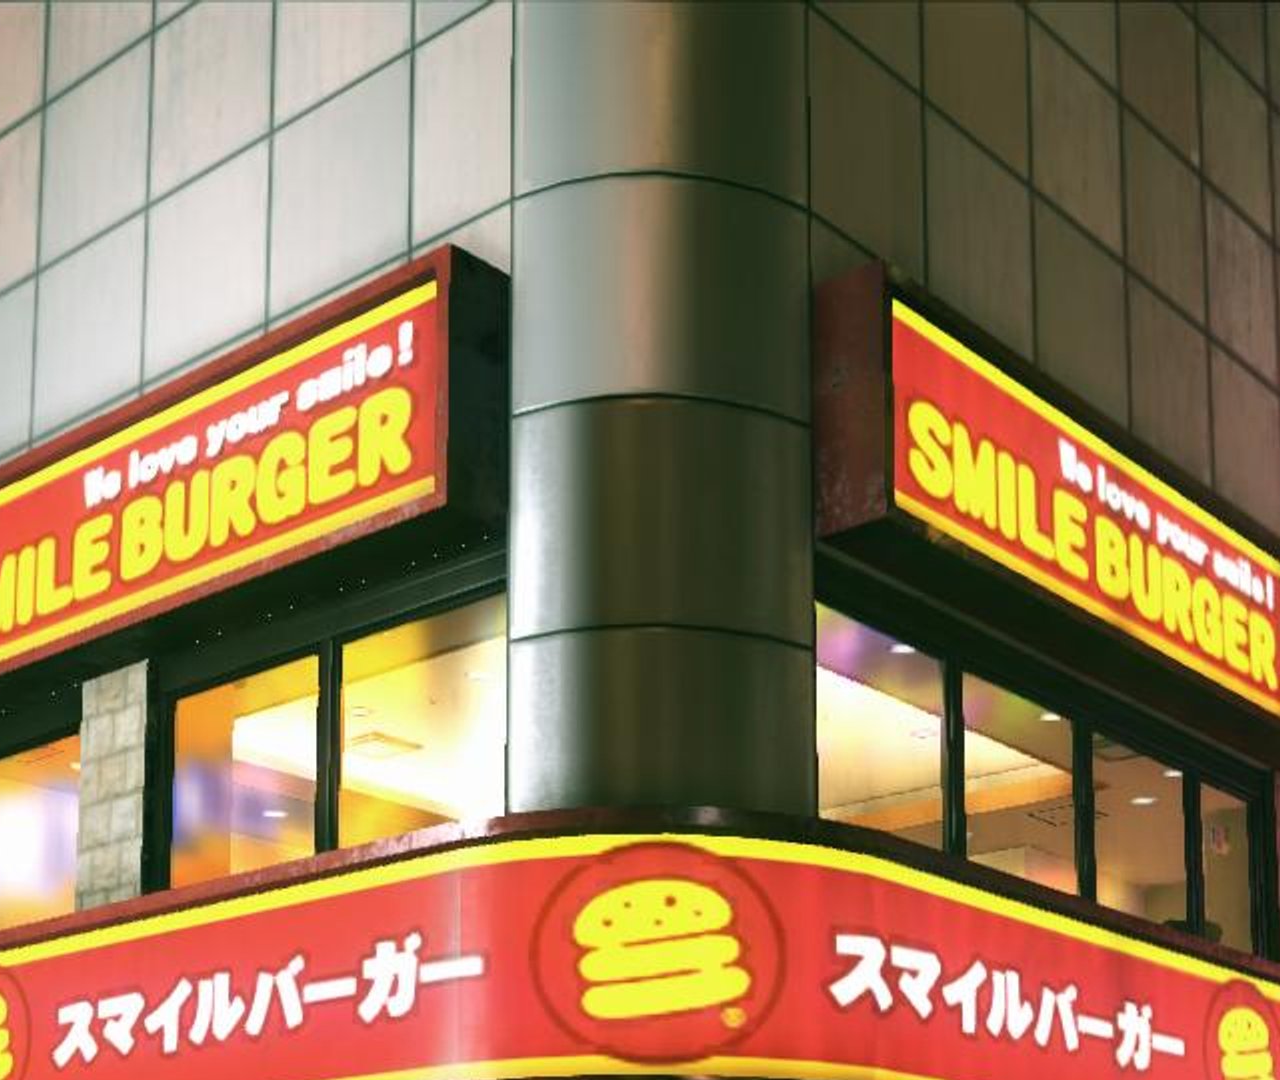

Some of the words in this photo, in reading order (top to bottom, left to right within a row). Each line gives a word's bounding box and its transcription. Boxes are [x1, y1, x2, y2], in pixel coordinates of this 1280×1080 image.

[84, 465, 120, 509] We
[129, 436, 196, 483] love
[207, 390, 289, 458] your
[297, 321, 413, 411] smile!
[120, 387, 413, 583] BURGER
[907, 400, 1089, 582] SMILE
[1094, 519, 1279, 692] BURGER
[1059, 437, 1093, 494] We
[1096, 464, 1150, 532] love
[1156, 504, 1207, 567] your
[1212, 548, 1274, 609] smile!
[51, 933, 485, 1067] スマイルバーガー
[829, 933, 1185, 1072] スマイルバーガー
